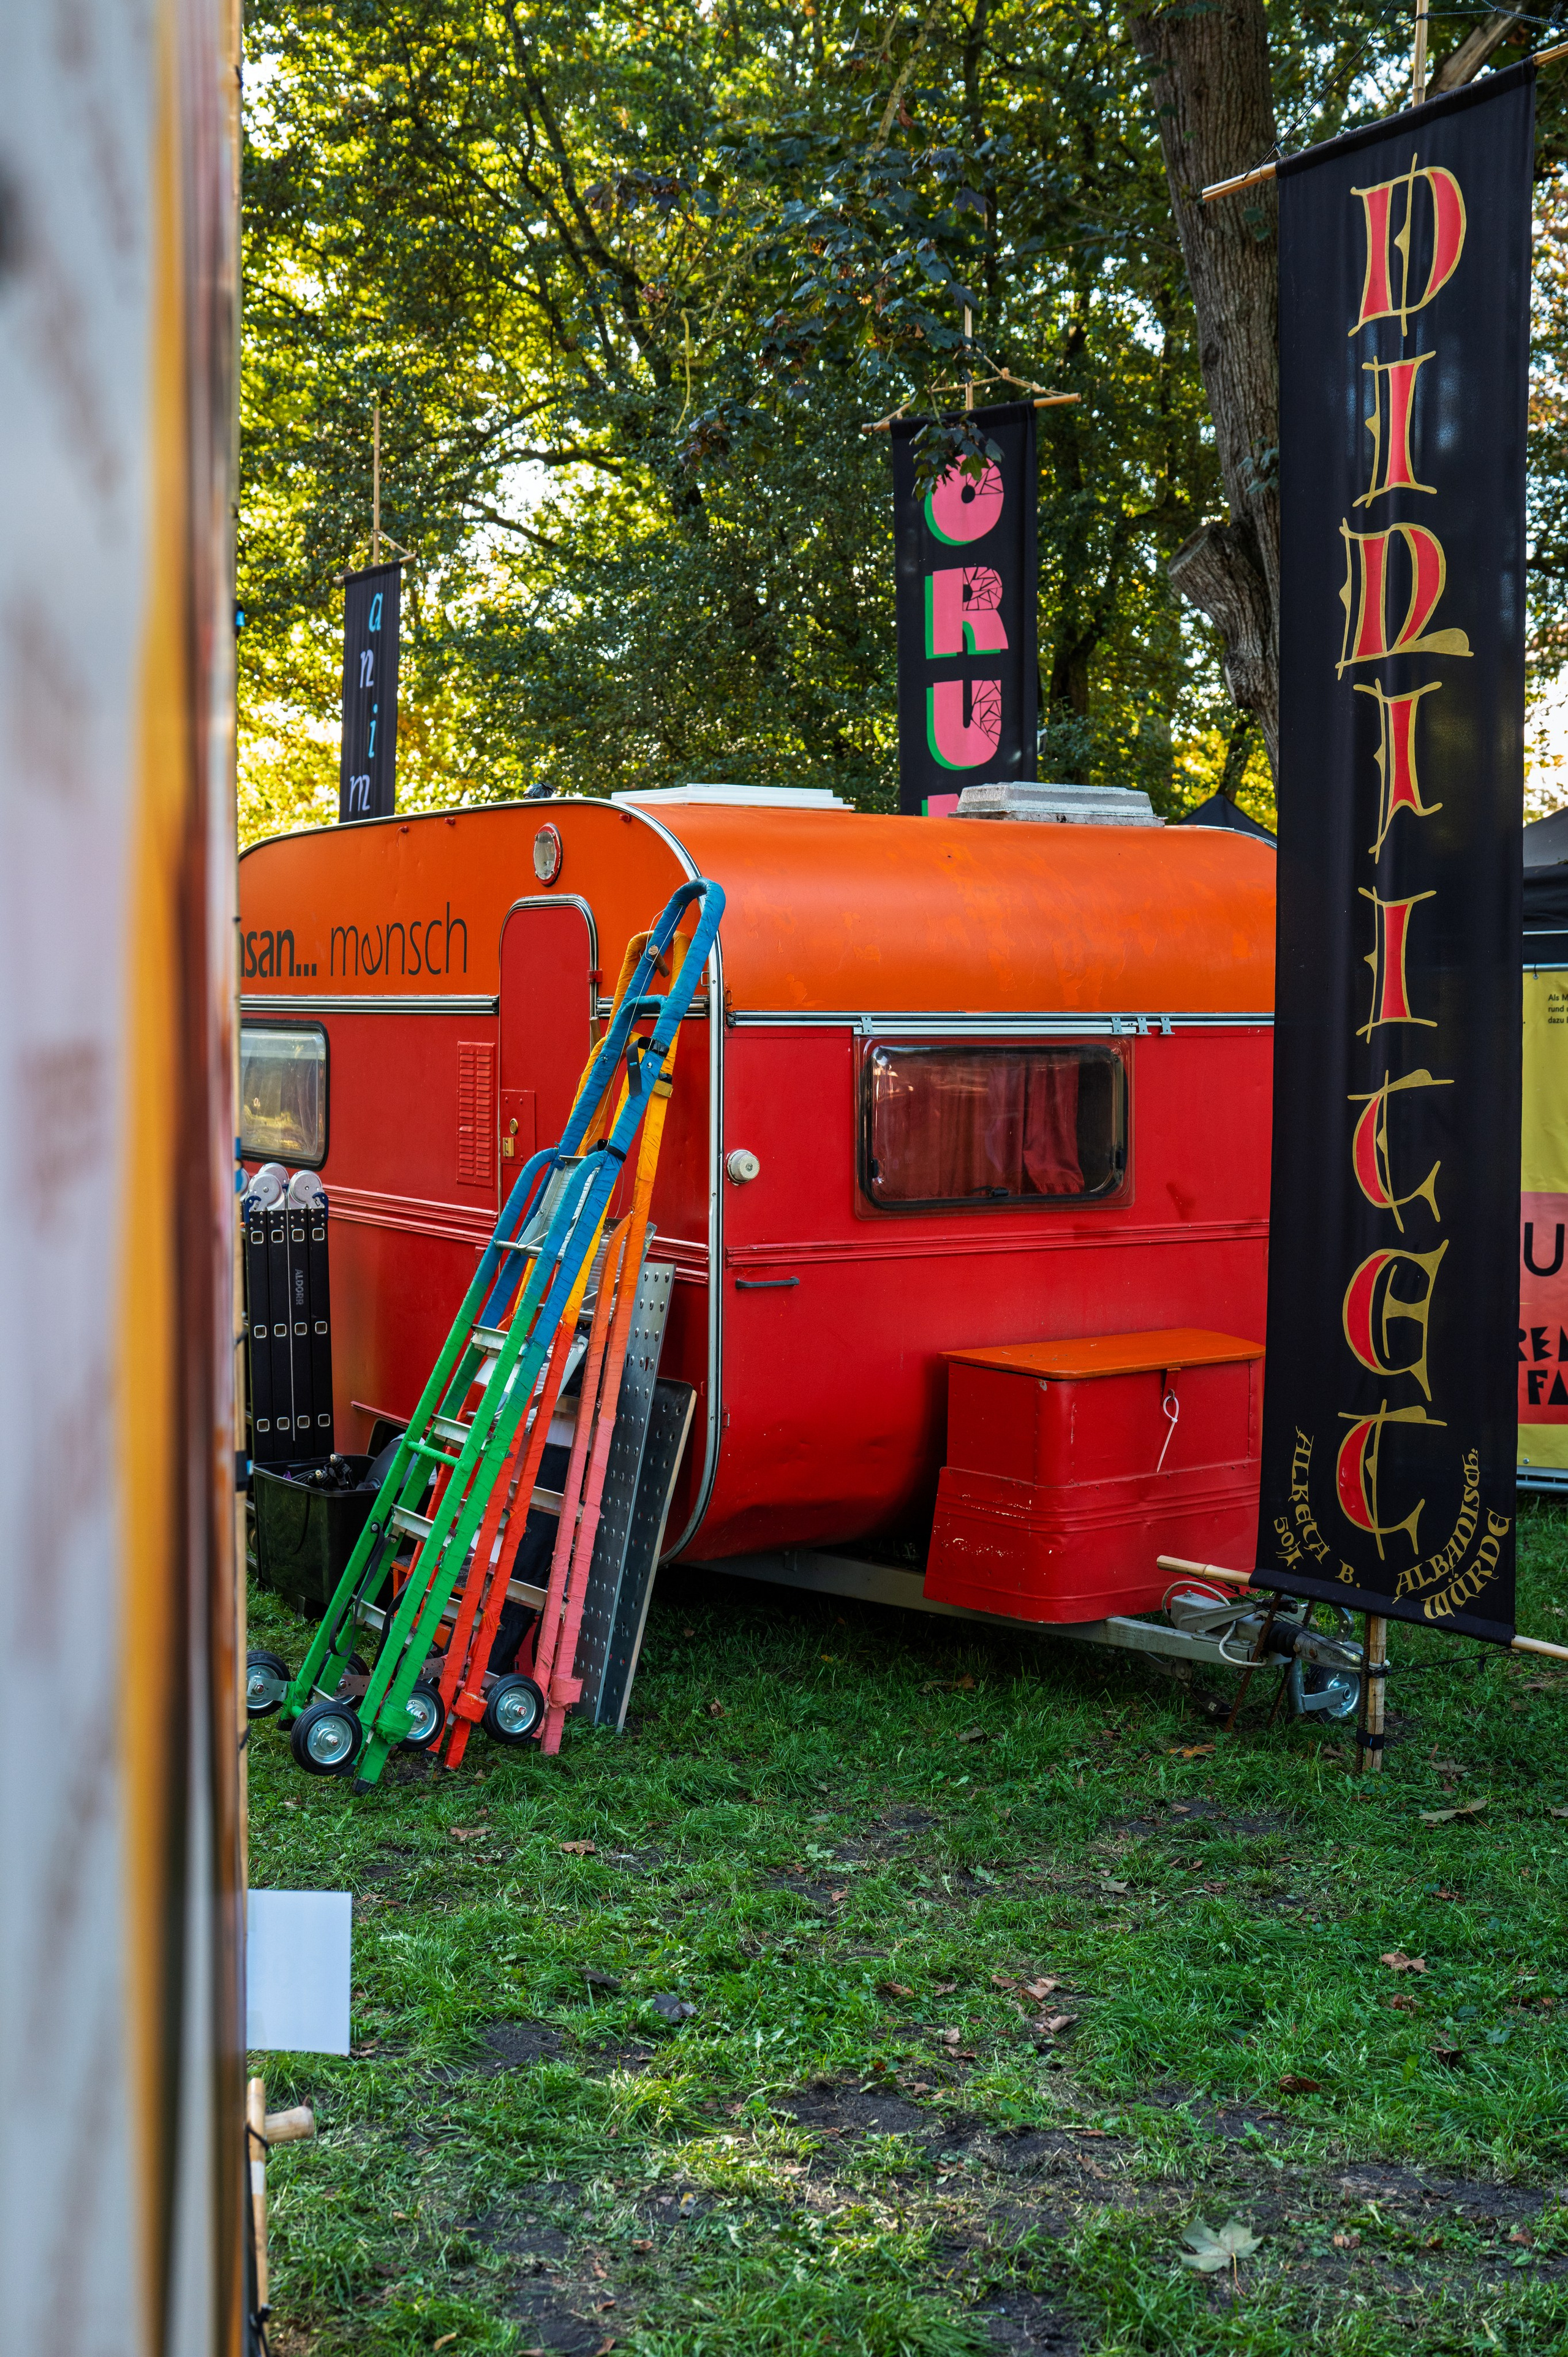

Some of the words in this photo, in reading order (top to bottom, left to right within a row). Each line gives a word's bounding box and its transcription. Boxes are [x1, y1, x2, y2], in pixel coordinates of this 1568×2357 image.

[921, 454, 1009, 817] ORU
[295, 1268, 304, 1306] ALDORR
[1335, 1559, 1361, 1588] B.
